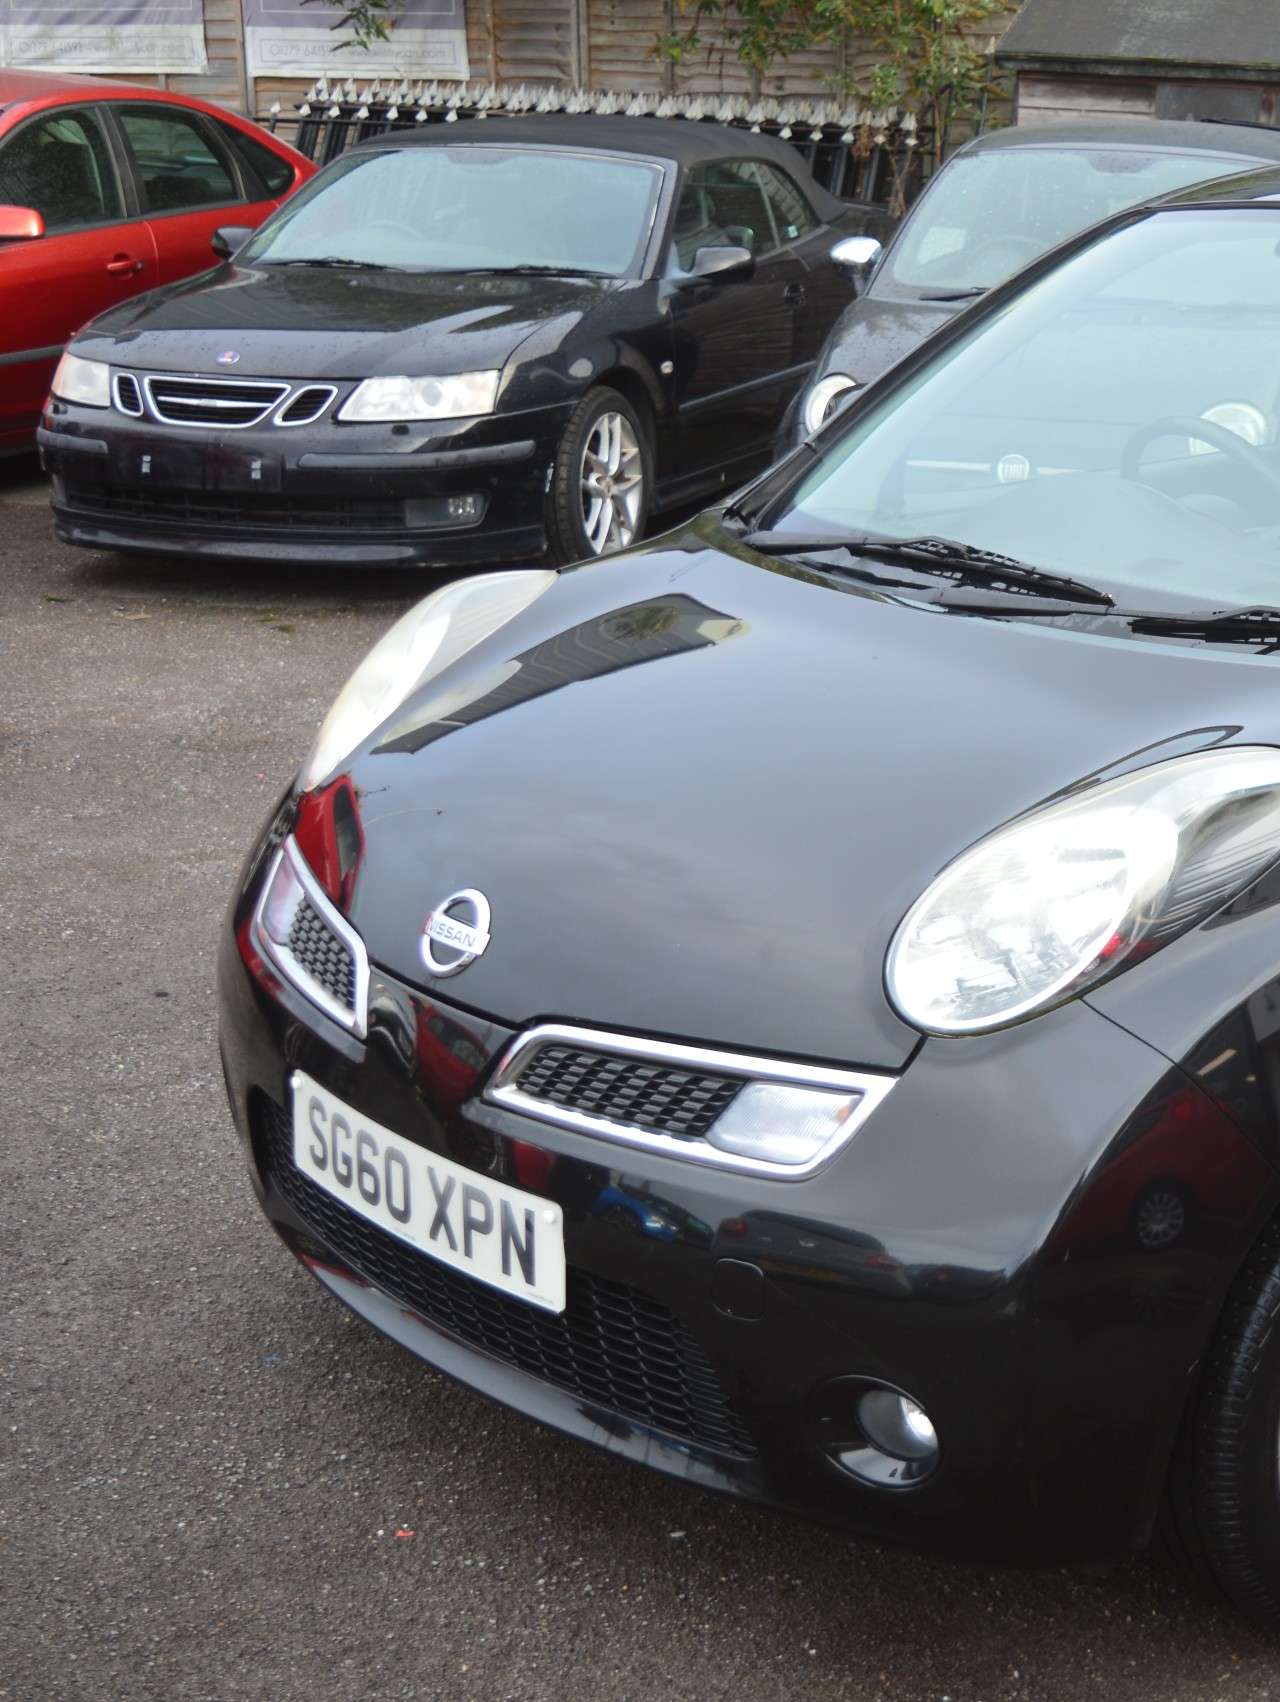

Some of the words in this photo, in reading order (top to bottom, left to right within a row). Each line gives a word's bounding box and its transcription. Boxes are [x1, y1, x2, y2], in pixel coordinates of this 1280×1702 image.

[428, 917, 477, 948] NISSAN
[307, 1095, 411, 1225] SG60
[426, 1164, 537, 1288] XPN
